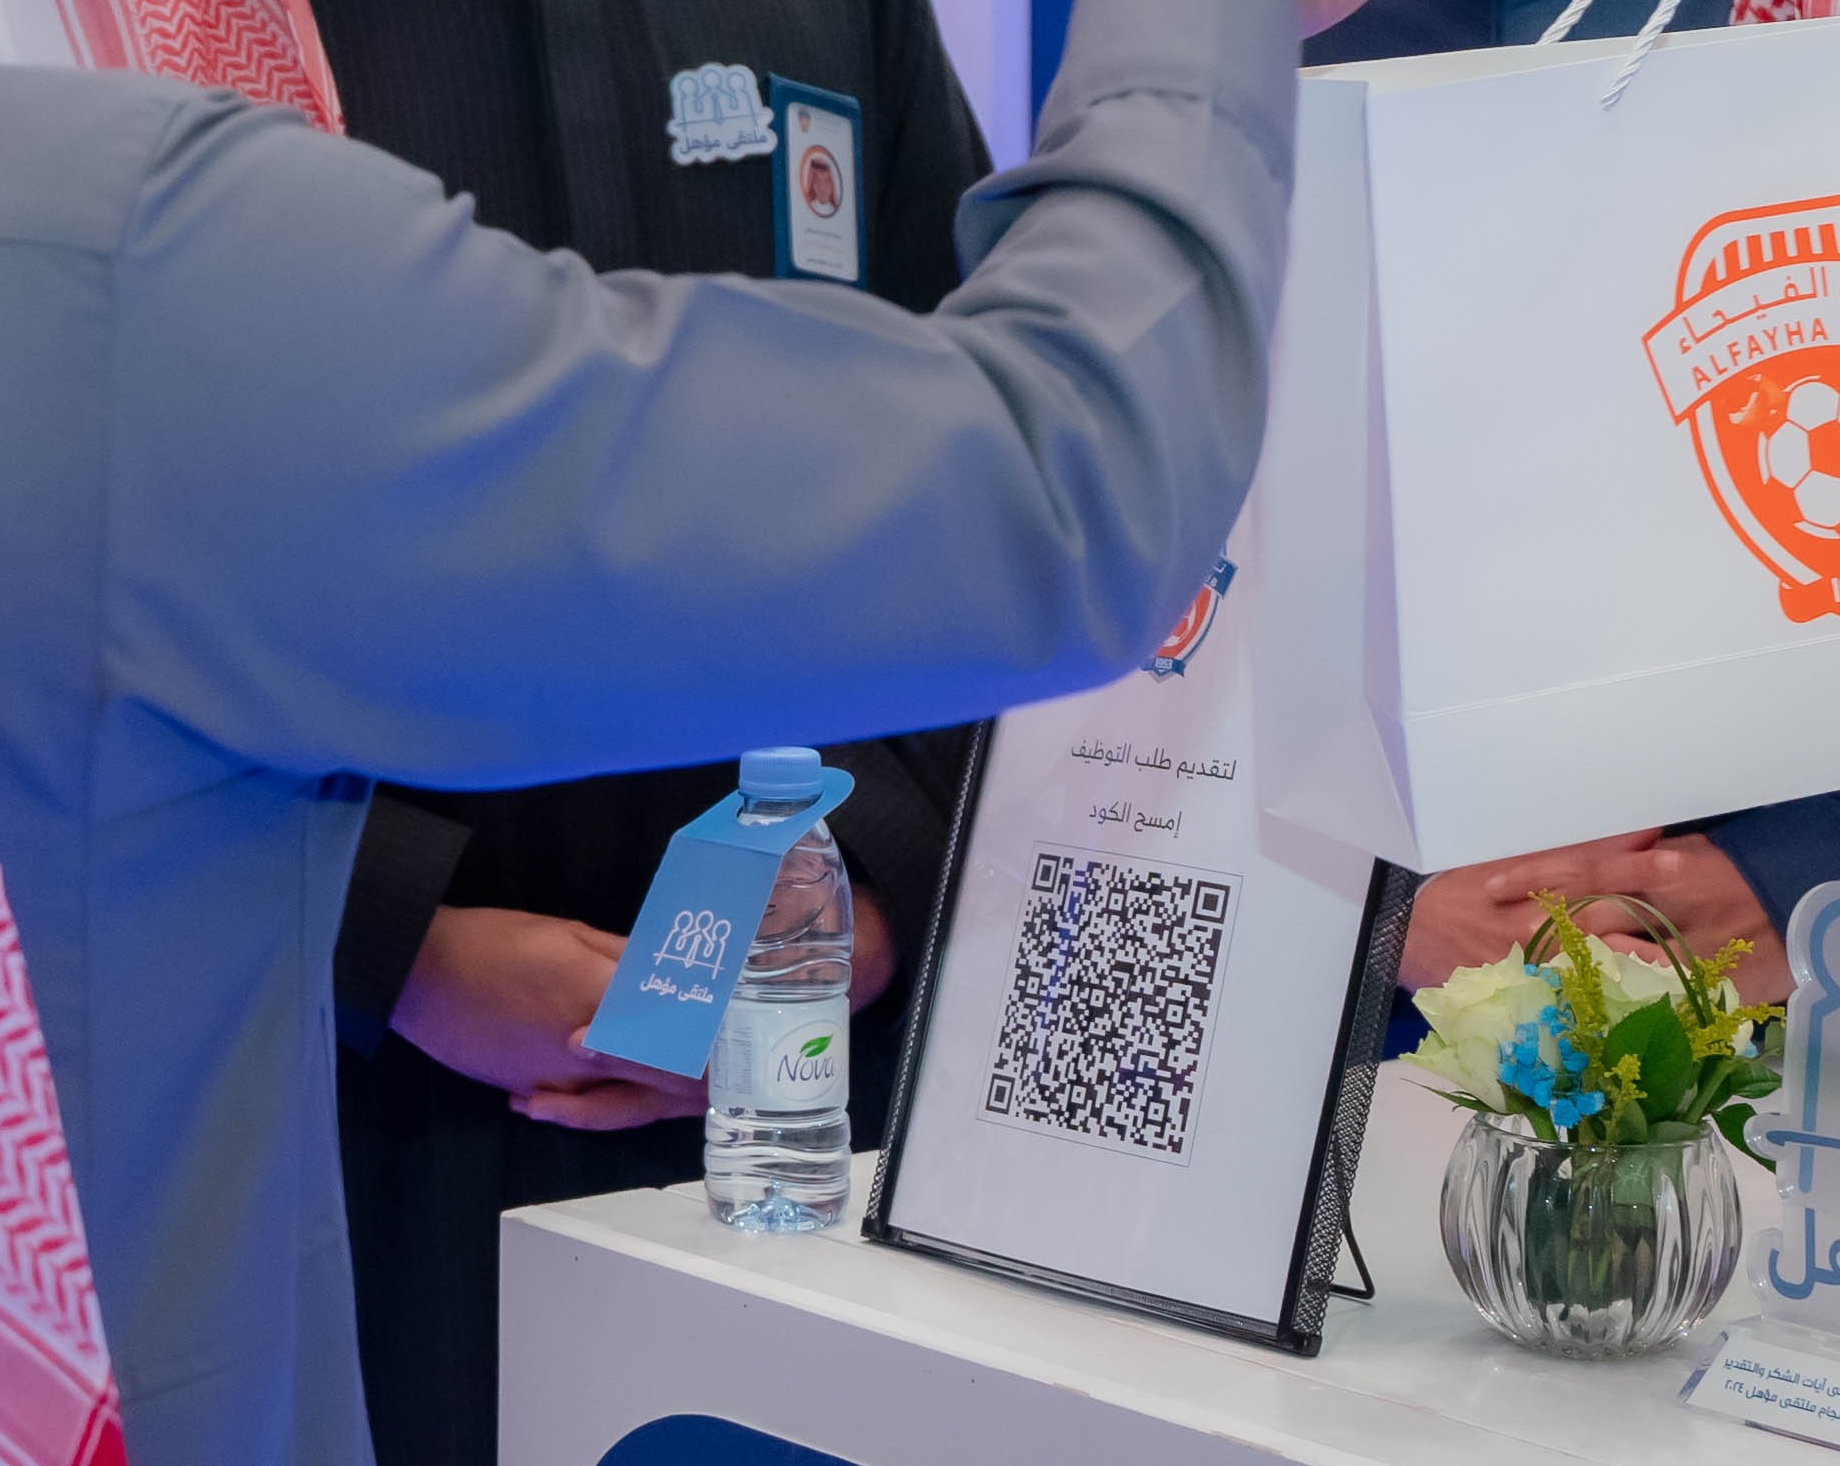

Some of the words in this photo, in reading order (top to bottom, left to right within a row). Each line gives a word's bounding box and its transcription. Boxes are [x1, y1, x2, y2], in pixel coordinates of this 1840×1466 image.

[1677, 266, 1829, 356] الفيحاء
[1691, 317, 1830, 391] ALFAYHA
[1071, 739, 1132, 765] التوظيف
[1134, 748, 1172, 772] طلب
[1176, 758, 1237, 781] لتقديم
[1088, 801, 1132, 824] الكود
[1133, 809, 1183, 839] إمسح
[639, 972, 677, 997] مؤهل
[677, 983, 714, 1004] ملتقى
[776, 1054, 835, 1083] Nova
[1723, 1357, 1766, 1378] والتقدير
[1766, 1368, 1800, 1385] الشكر
[1745, 1385, 1778, 1403] مؤهل
[1778, 1396, 1817, 1413] ملتقى
